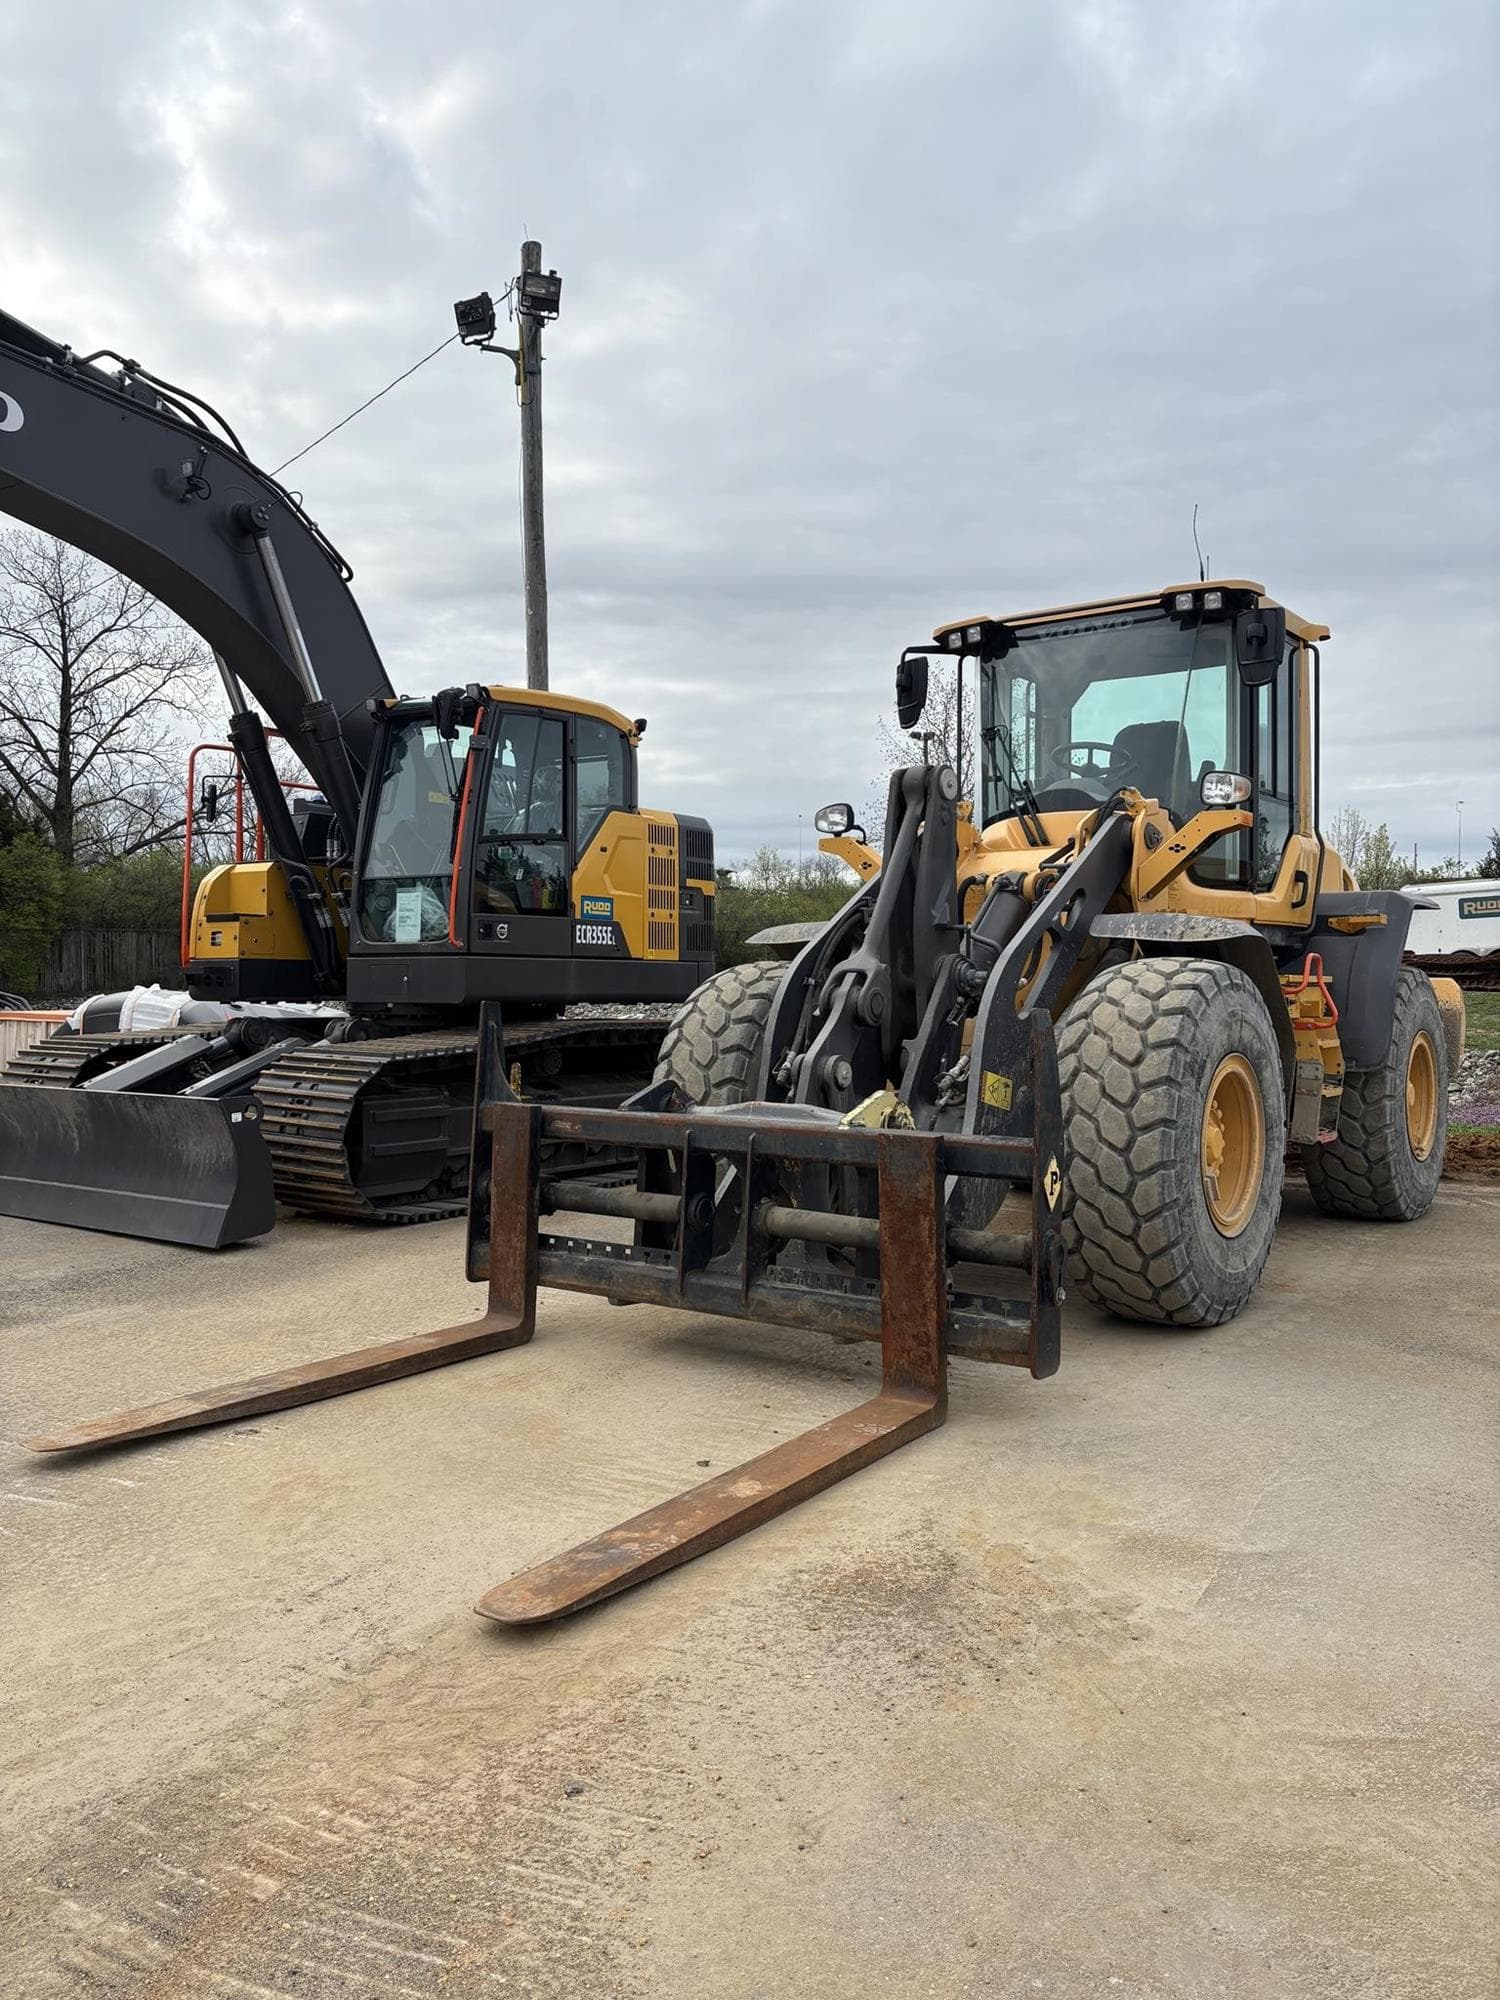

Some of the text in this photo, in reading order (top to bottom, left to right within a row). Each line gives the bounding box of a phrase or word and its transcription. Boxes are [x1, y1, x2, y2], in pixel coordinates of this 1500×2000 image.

[1037, 616, 1133, 641] VOLVO
[583, 900, 611, 915] RUDD
[1463, 900, 1500, 915] RUD
